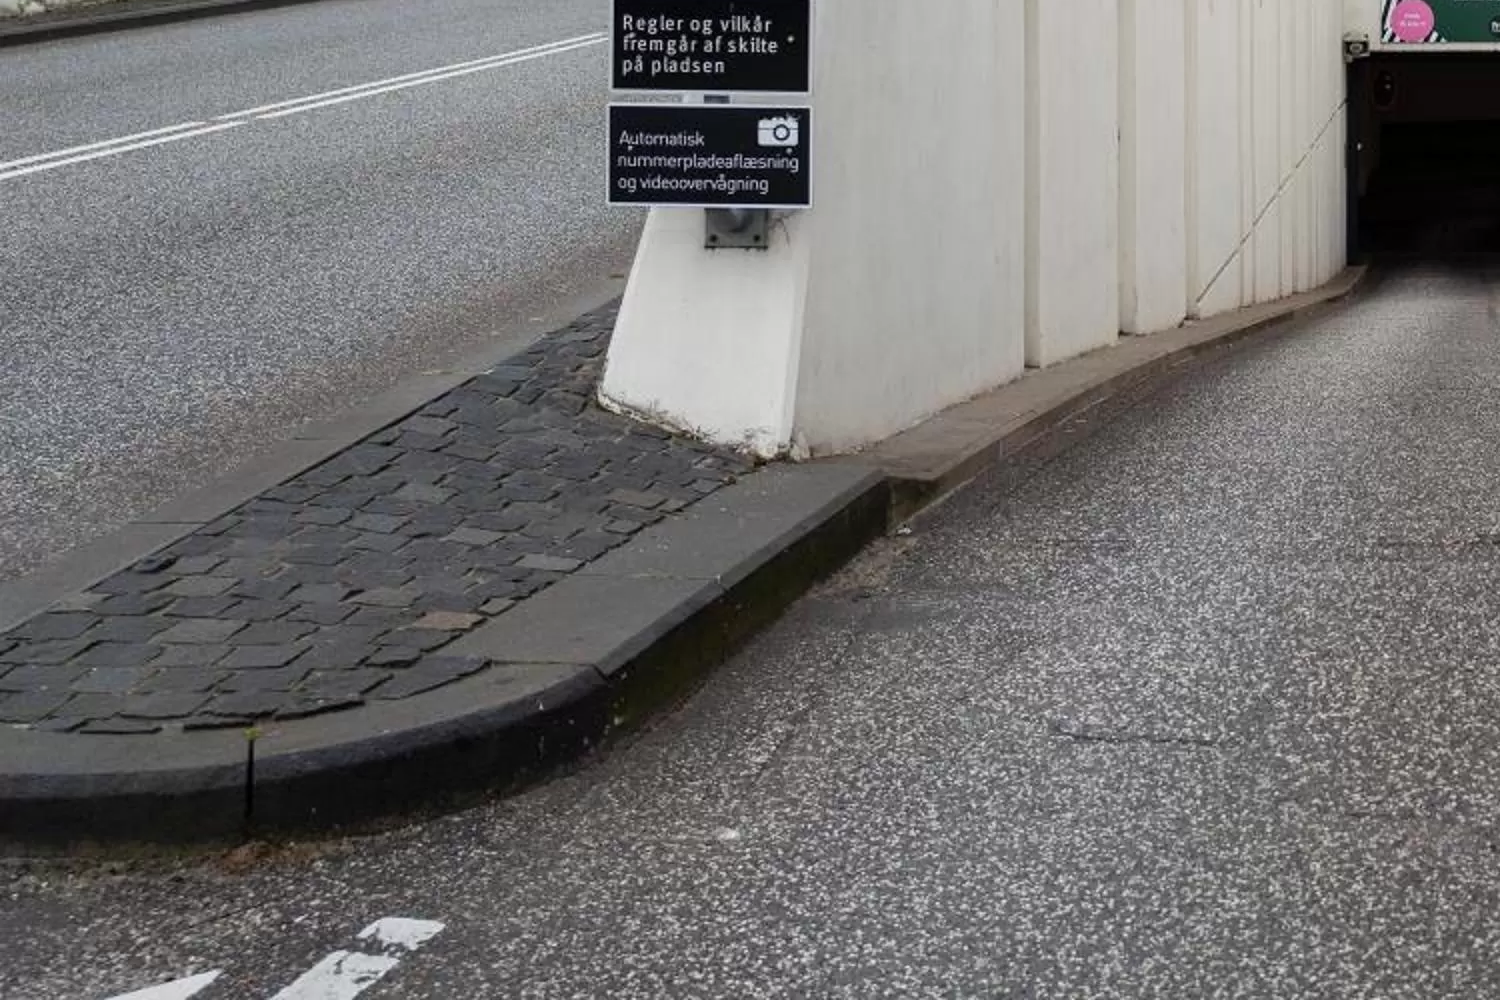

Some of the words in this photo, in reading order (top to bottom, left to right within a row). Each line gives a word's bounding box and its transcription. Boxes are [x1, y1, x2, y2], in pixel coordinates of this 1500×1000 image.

[622, 14, 683, 34] Regler
[690, 18, 713, 34] og
[720, 15, 772, 33] vilkår
[623, 34, 697, 55] fremgår
[703, 36, 721, 53] af
[727, 36, 778, 53] skilte
[622, 55, 643, 76] på
[651, 57, 725, 76] pladsen
[619, 130, 704, 146] Automatisk
[617, 154, 799, 173] nummerpladeaflæsning
[618, 177, 636, 193] og
[640, 174, 769, 194] videoovervågning
